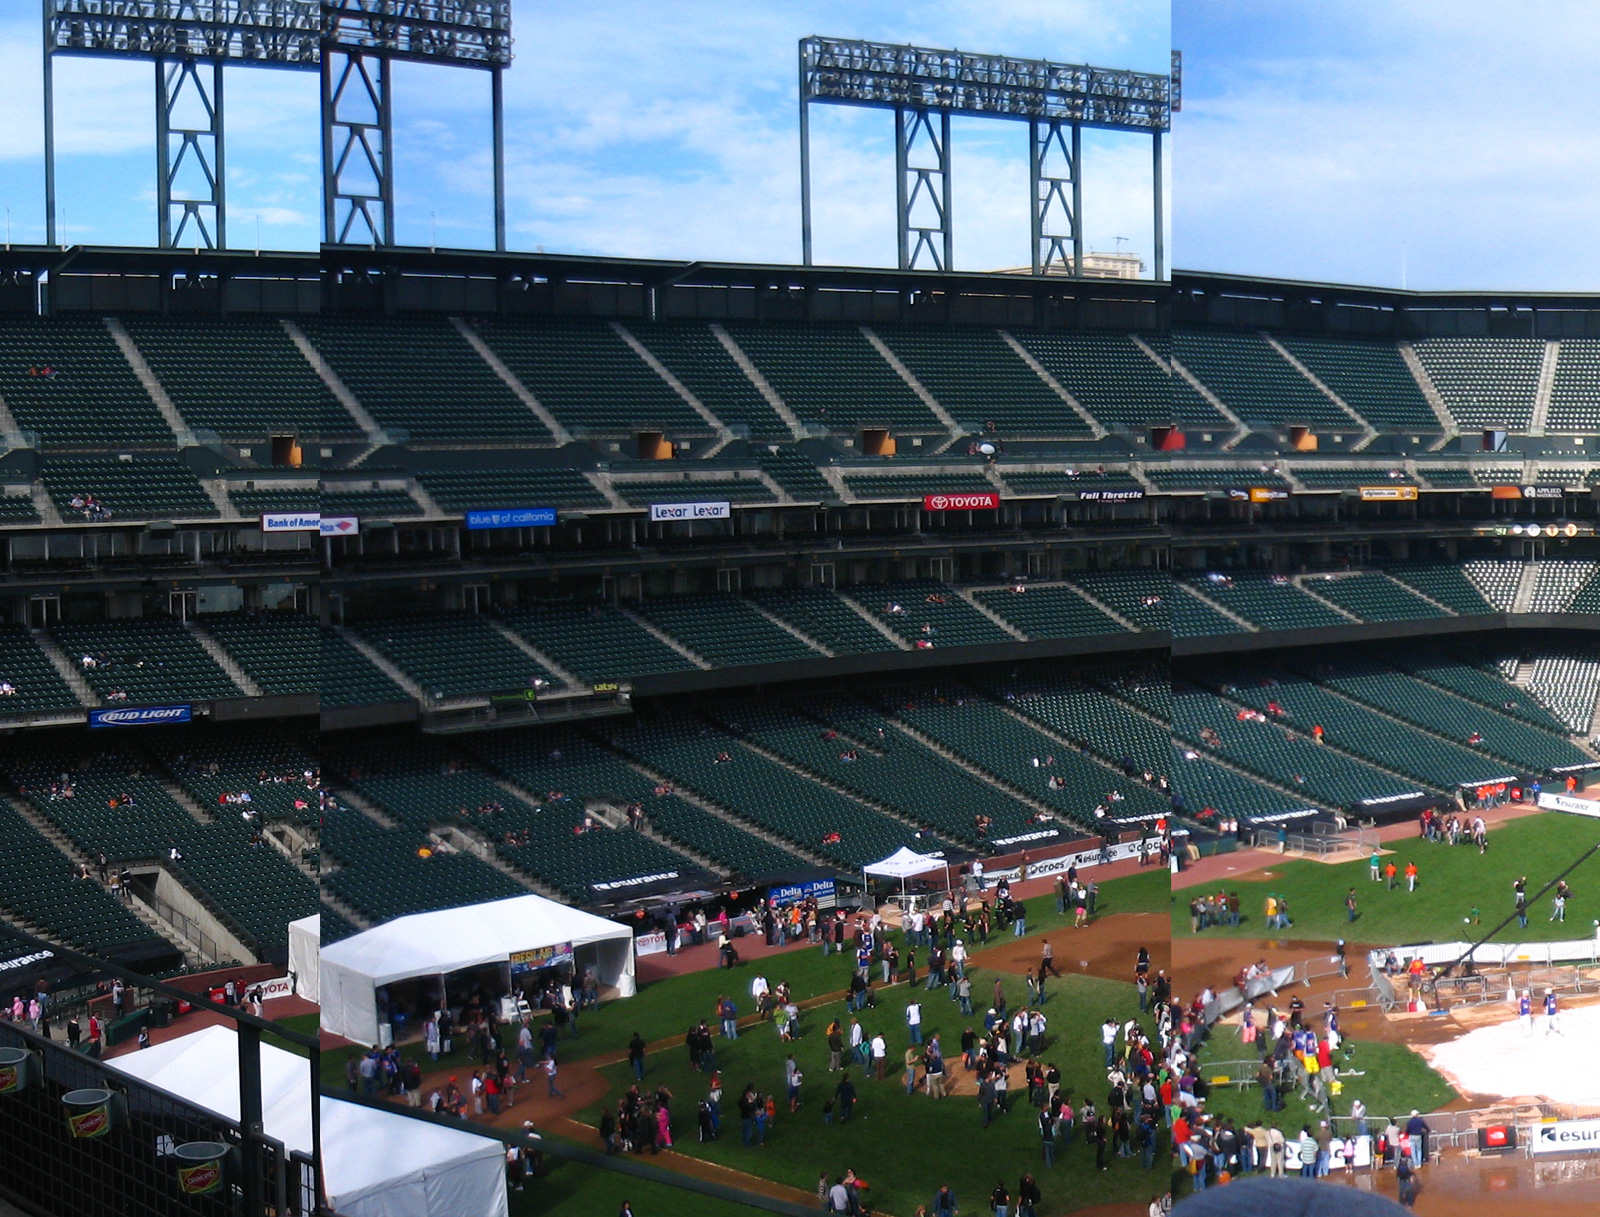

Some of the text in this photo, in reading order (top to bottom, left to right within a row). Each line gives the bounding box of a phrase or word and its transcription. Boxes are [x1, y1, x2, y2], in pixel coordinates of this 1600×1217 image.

[949, 496, 992, 507] TOYOTA
[1080, 491, 1142, 500] Full Throttle
[471, 511, 553, 524] blue of california
[656, 505, 723, 518] Lexar Lexar
[268, 518, 289, 527] Bank
[289, 518, 298, 527] of
[108, 709, 185, 721] BUD LIGHT
[1004, 829, 1059, 845] esurance
[1039, 861, 1064, 873] crocs
[610, 871, 679, 889] esurance
[813, 880, 834, 890] Delta
[781, 887, 801, 898] Delta
[511, 949, 538, 963] FRESH
